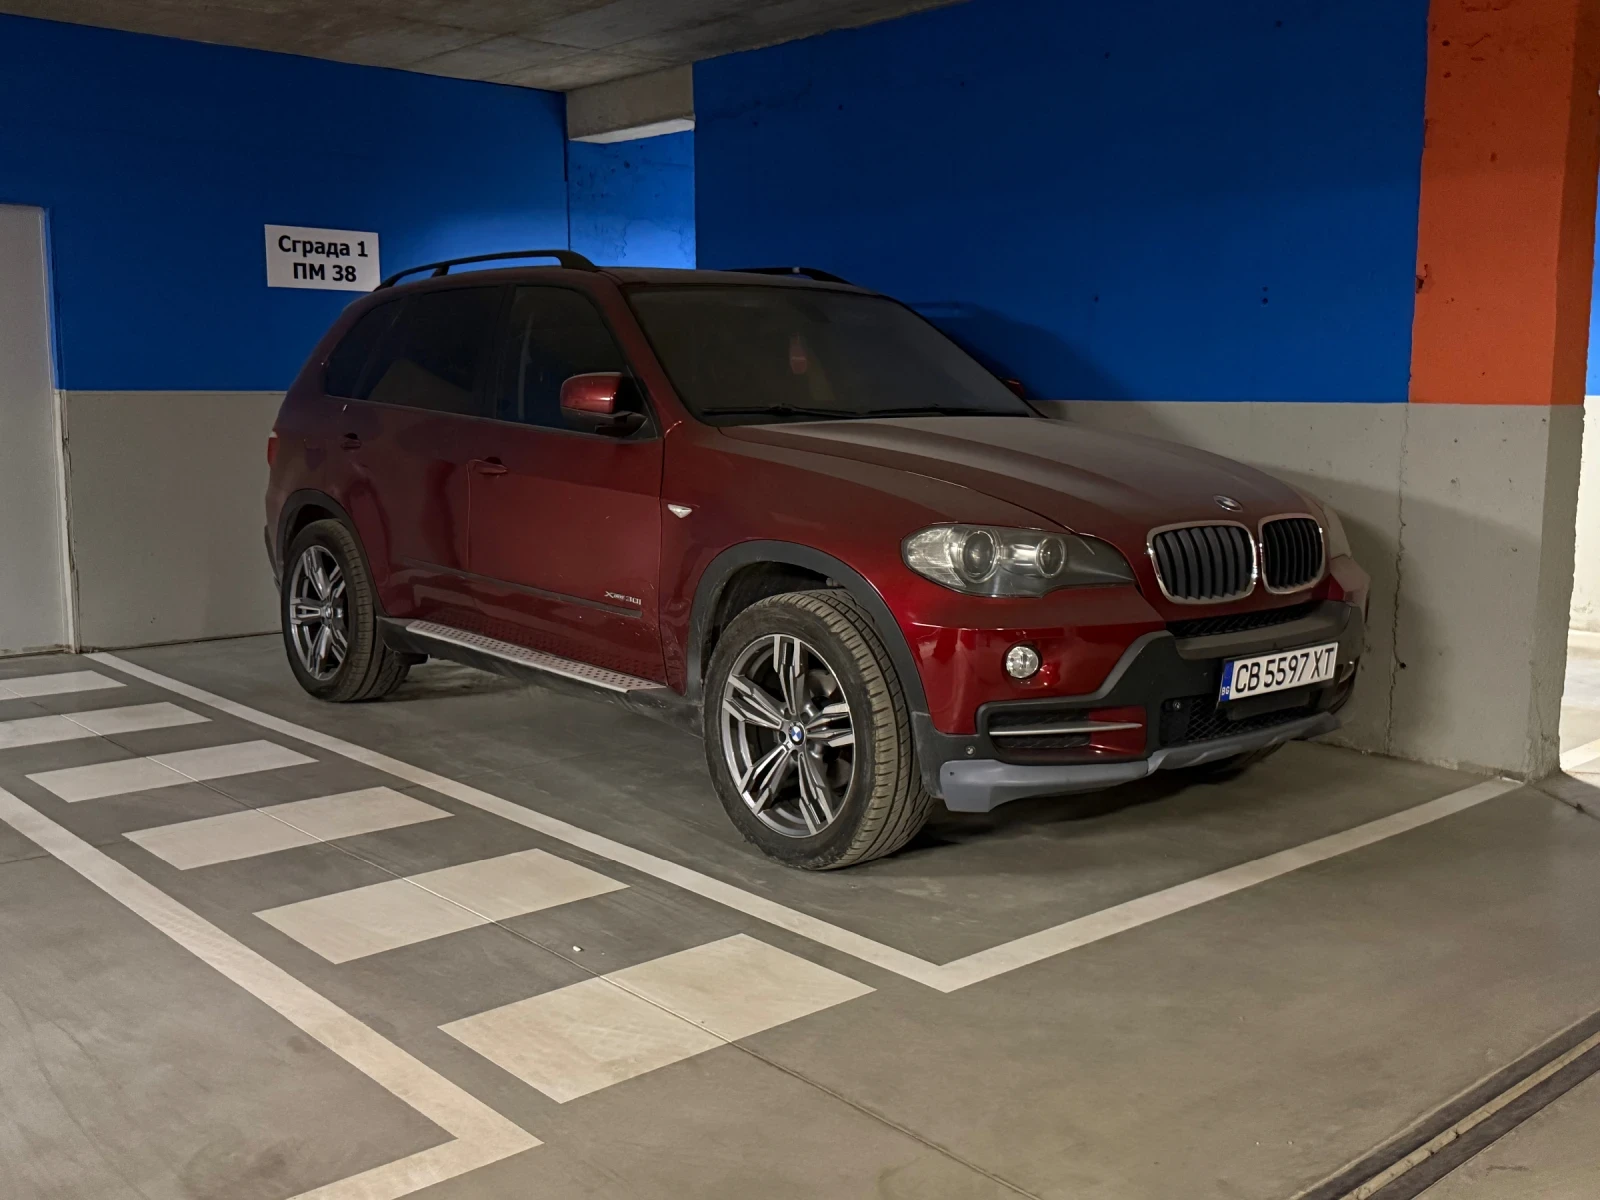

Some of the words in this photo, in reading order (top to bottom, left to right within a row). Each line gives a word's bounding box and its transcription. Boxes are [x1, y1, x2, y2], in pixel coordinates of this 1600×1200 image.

[278, 235, 350, 258] Сграда
[357, 241, 368, 257] 1
[293, 262, 325, 280] ПМ
[332, 265, 357, 282] 38
